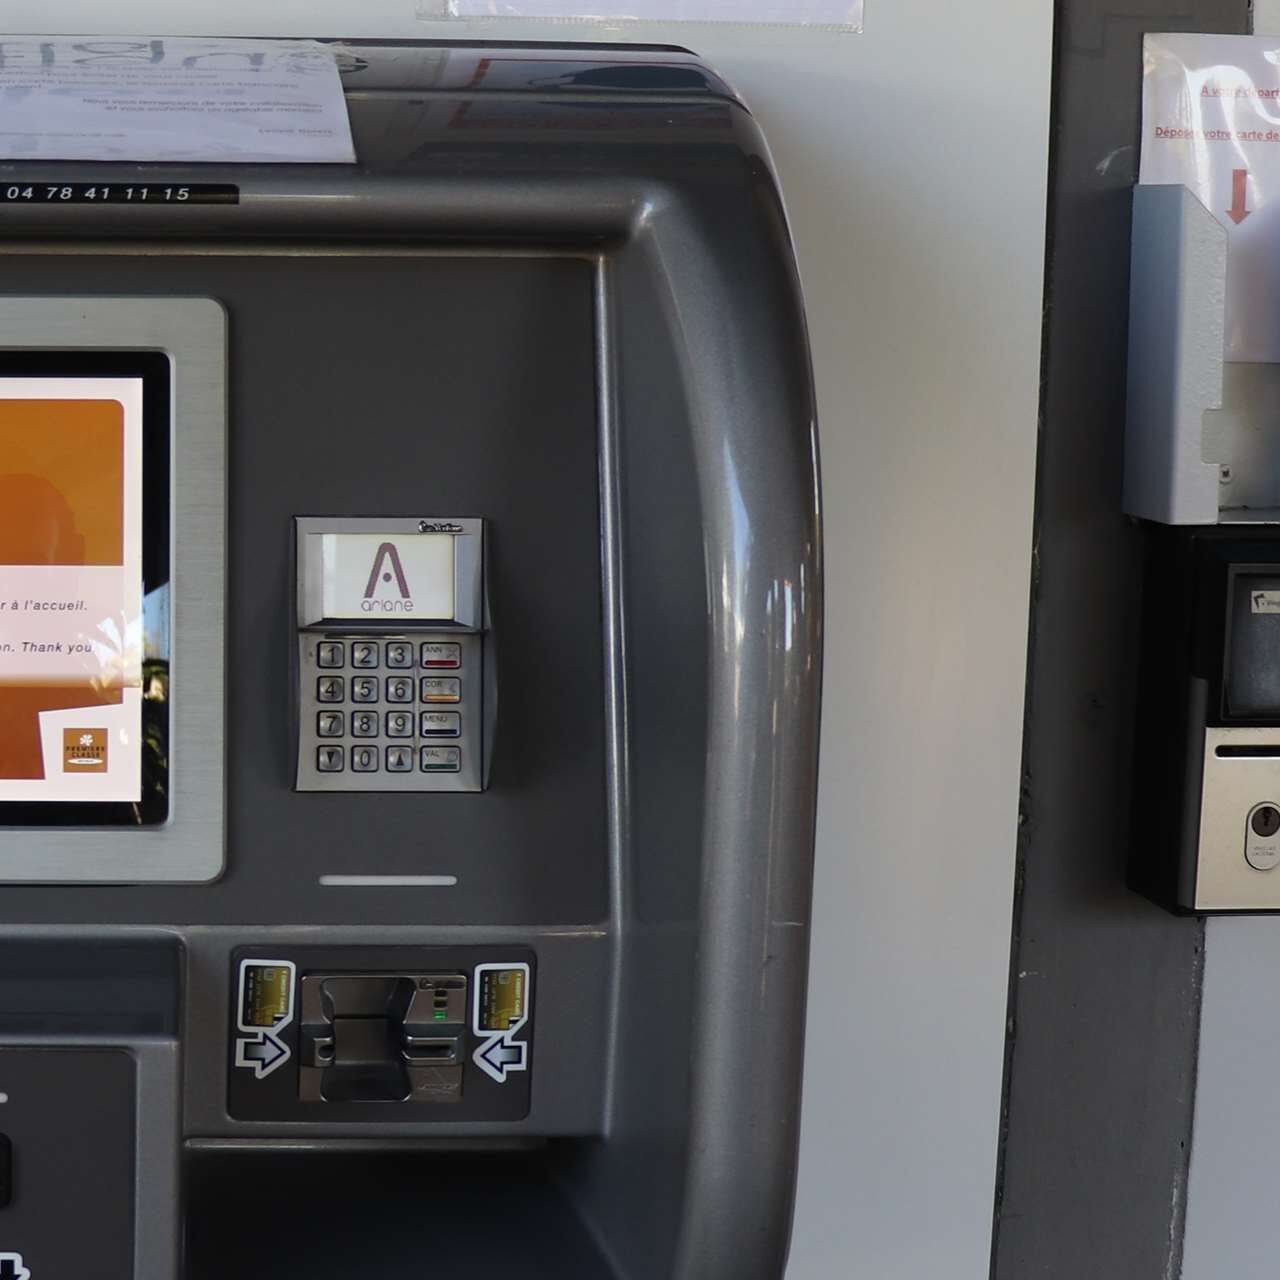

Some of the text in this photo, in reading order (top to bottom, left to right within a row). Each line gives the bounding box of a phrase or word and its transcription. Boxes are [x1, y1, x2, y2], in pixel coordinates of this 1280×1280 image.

[7, 187, 32, 199] 04
[48, 187, 72, 199] 78
[85, 188, 109, 199] 41
[127, 188, 147, 199] 11
[166, 188, 189, 200] 15
[11, 600, 18, 610] à
[24, 600, 87, 610] l'accueil.
[361, 599, 414, 612] ariane
[22, 642, 62, 652] Thank
[328, 647, 335, 663] 1
[360, 647, 371, 663] 2
[394, 647, 405, 663] 3
[325, 681, 336, 697] 4
[360, 681, 371, 697] 5
[395, 682, 405, 698] 6
[326, 715, 337, 732] 7
[360, 716, 370, 732] 8
[395, 717, 405, 733] 9
[360, 750, 370, 767] 0
